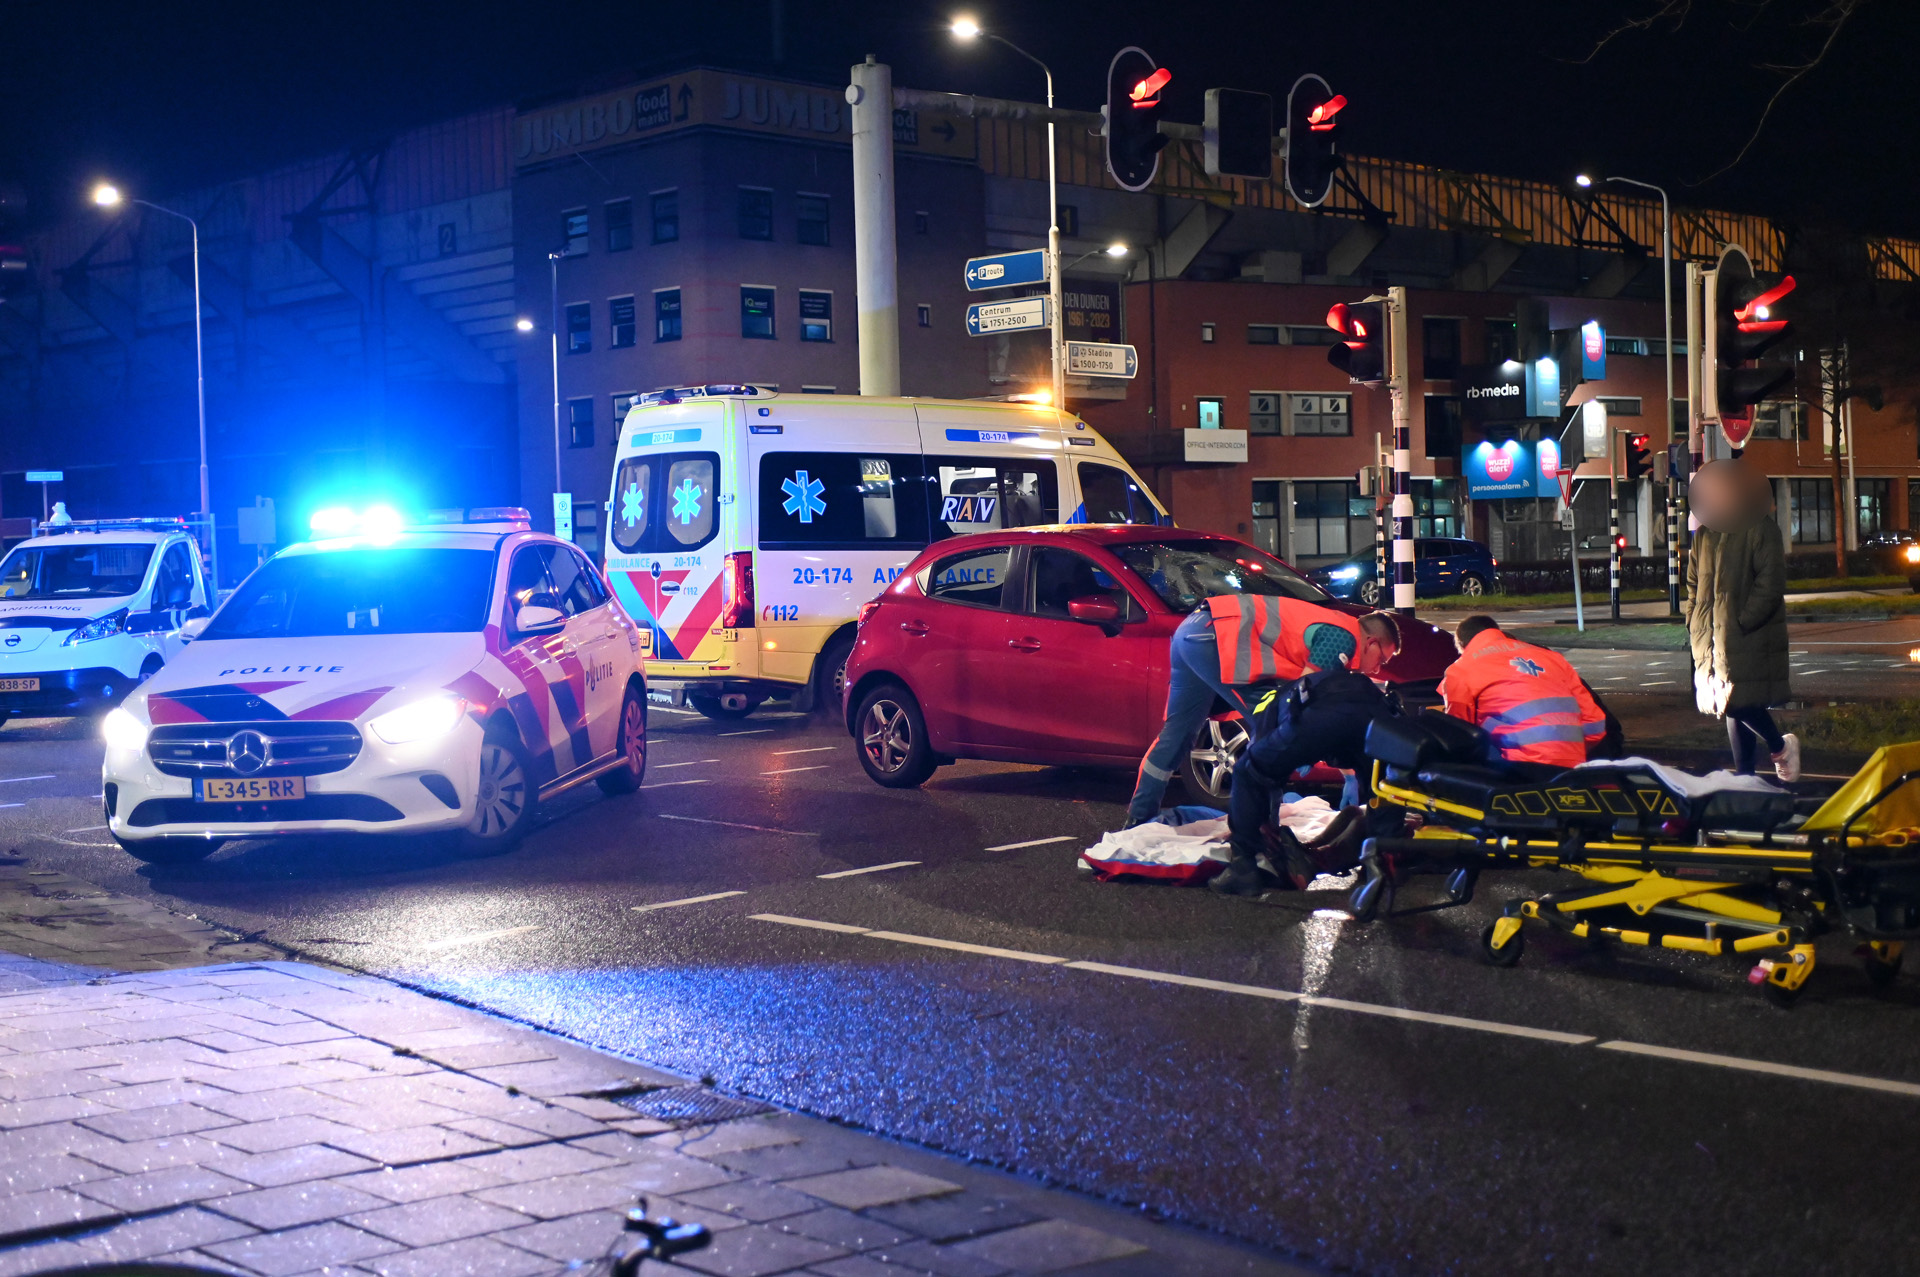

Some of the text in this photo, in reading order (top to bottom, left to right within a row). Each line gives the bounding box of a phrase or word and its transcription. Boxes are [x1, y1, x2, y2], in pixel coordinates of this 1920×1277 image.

[636, 88, 668, 113] food
[637, 108, 670, 129] markt
[893, 111, 915, 128] od
[515, 97, 633, 159] JUMBO
[441, 226, 454, 253] 2
[987, 267, 1003, 275] route
[1064, 291, 1079, 308] DEN
[1080, 293, 1110, 310] DUNGEN
[980, 306, 1012, 316] Centrum
[989, 315, 1027, 328] 1751-2500
[1067, 311, 1085, 326] 1961
[1090, 312, 1110, 328] 2023
[1088, 346, 1113, 357] Stadion
[1080, 360, 1113, 369] 1500-1750
[653, 432, 674, 443] 20-174
[981, 432, 1007, 441] 20-174
[1489, 464, 1509, 473] alert
[1472, 482, 1521, 493] persoonsalarm
[940, 497, 996, 521] RAV
[607, 557, 650, 569] AMBULANCE
[674, 556, 701, 568] 20-174
[793, 567, 996, 585] 20-174 AMLANCE
[218, 665, 345, 677] POLITIE
[208, 779, 295, 799] L-345-RR
[1558, 794, 1586, 805] XPS
